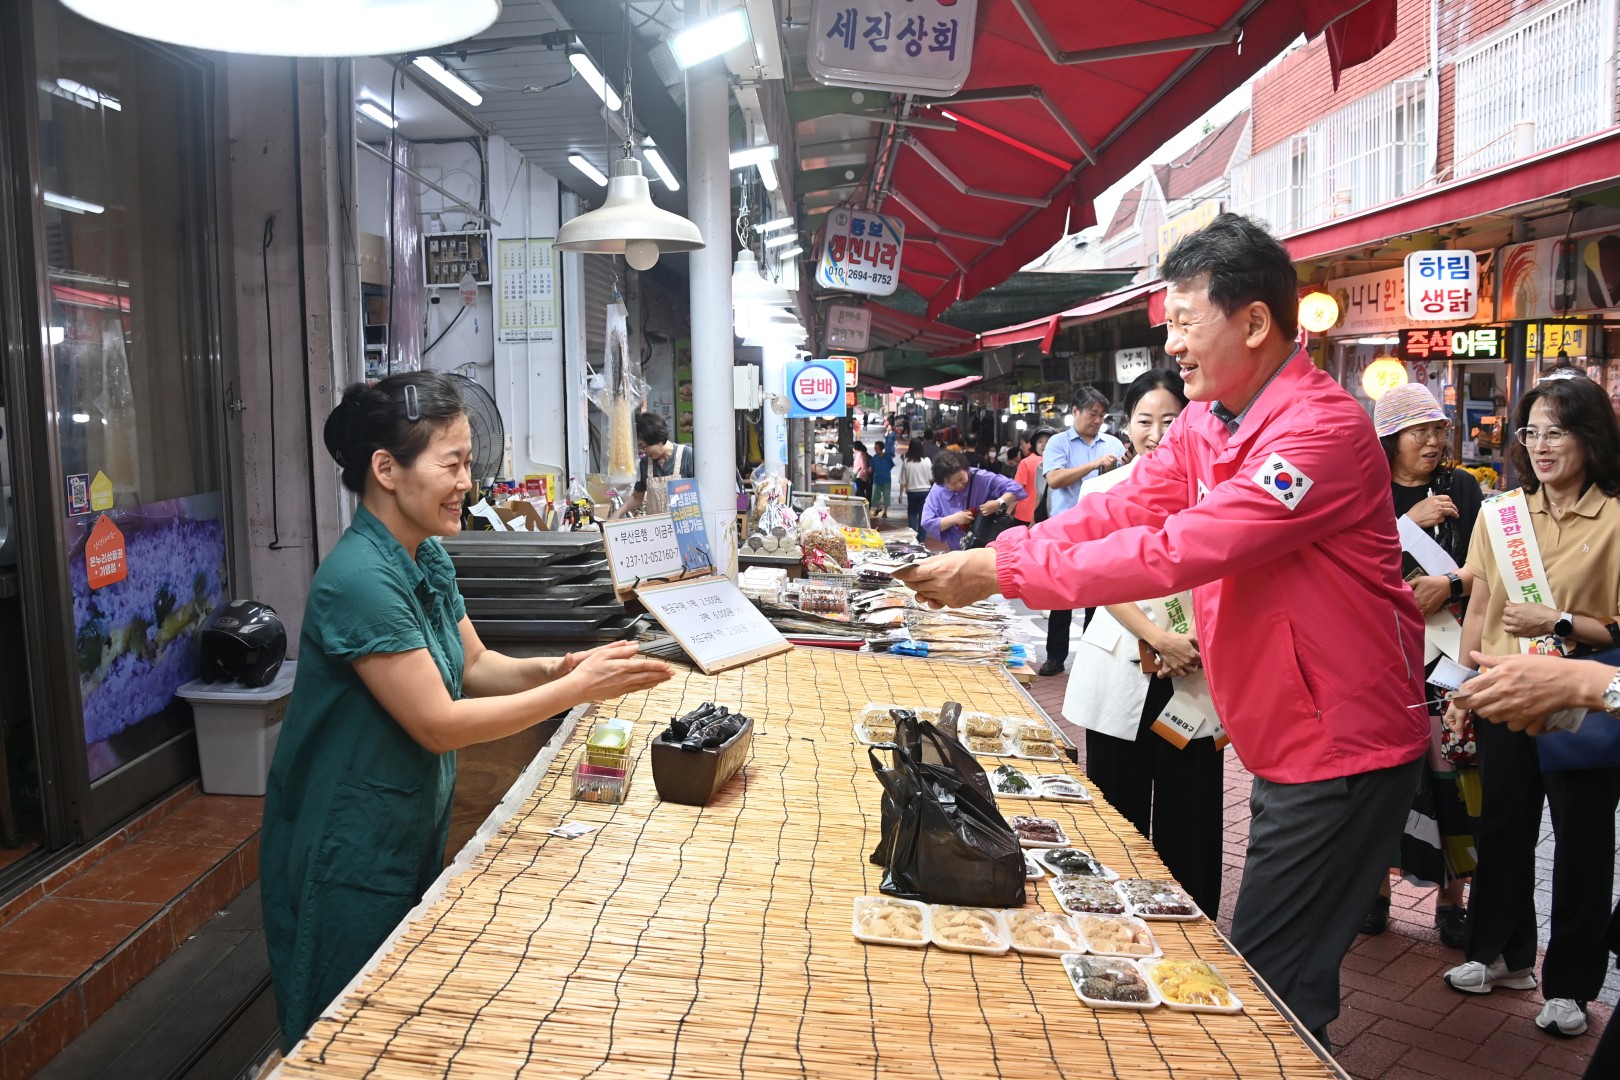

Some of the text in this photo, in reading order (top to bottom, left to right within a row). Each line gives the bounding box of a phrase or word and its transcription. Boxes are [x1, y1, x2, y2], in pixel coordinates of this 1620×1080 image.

[826, 8, 958, 61] 세진상회
[828, 266, 892, 285] 010-2694-8752
[1418, 255, 1470, 281] 하림
[1420, 288, 1472, 314] 생닭
[1405, 329, 1498, 358] 즉석어묵
[799, 378, 833, 395] 담배
[673, 505, 701, 521] 소비쿠폰
[620, 524, 674, 545] 부산은행 이금주
[676, 519, 704, 535] 사용가능
[89, 548, 123, 568] 온누리상품권
[1497, 505, 1543, 604] 행복한 추석명절 보내
[99, 562, 117, 577] 가맹점
[1164, 596, 1189, 635] 보내세요
[1170, 714, 1195, 733] 해운대구
